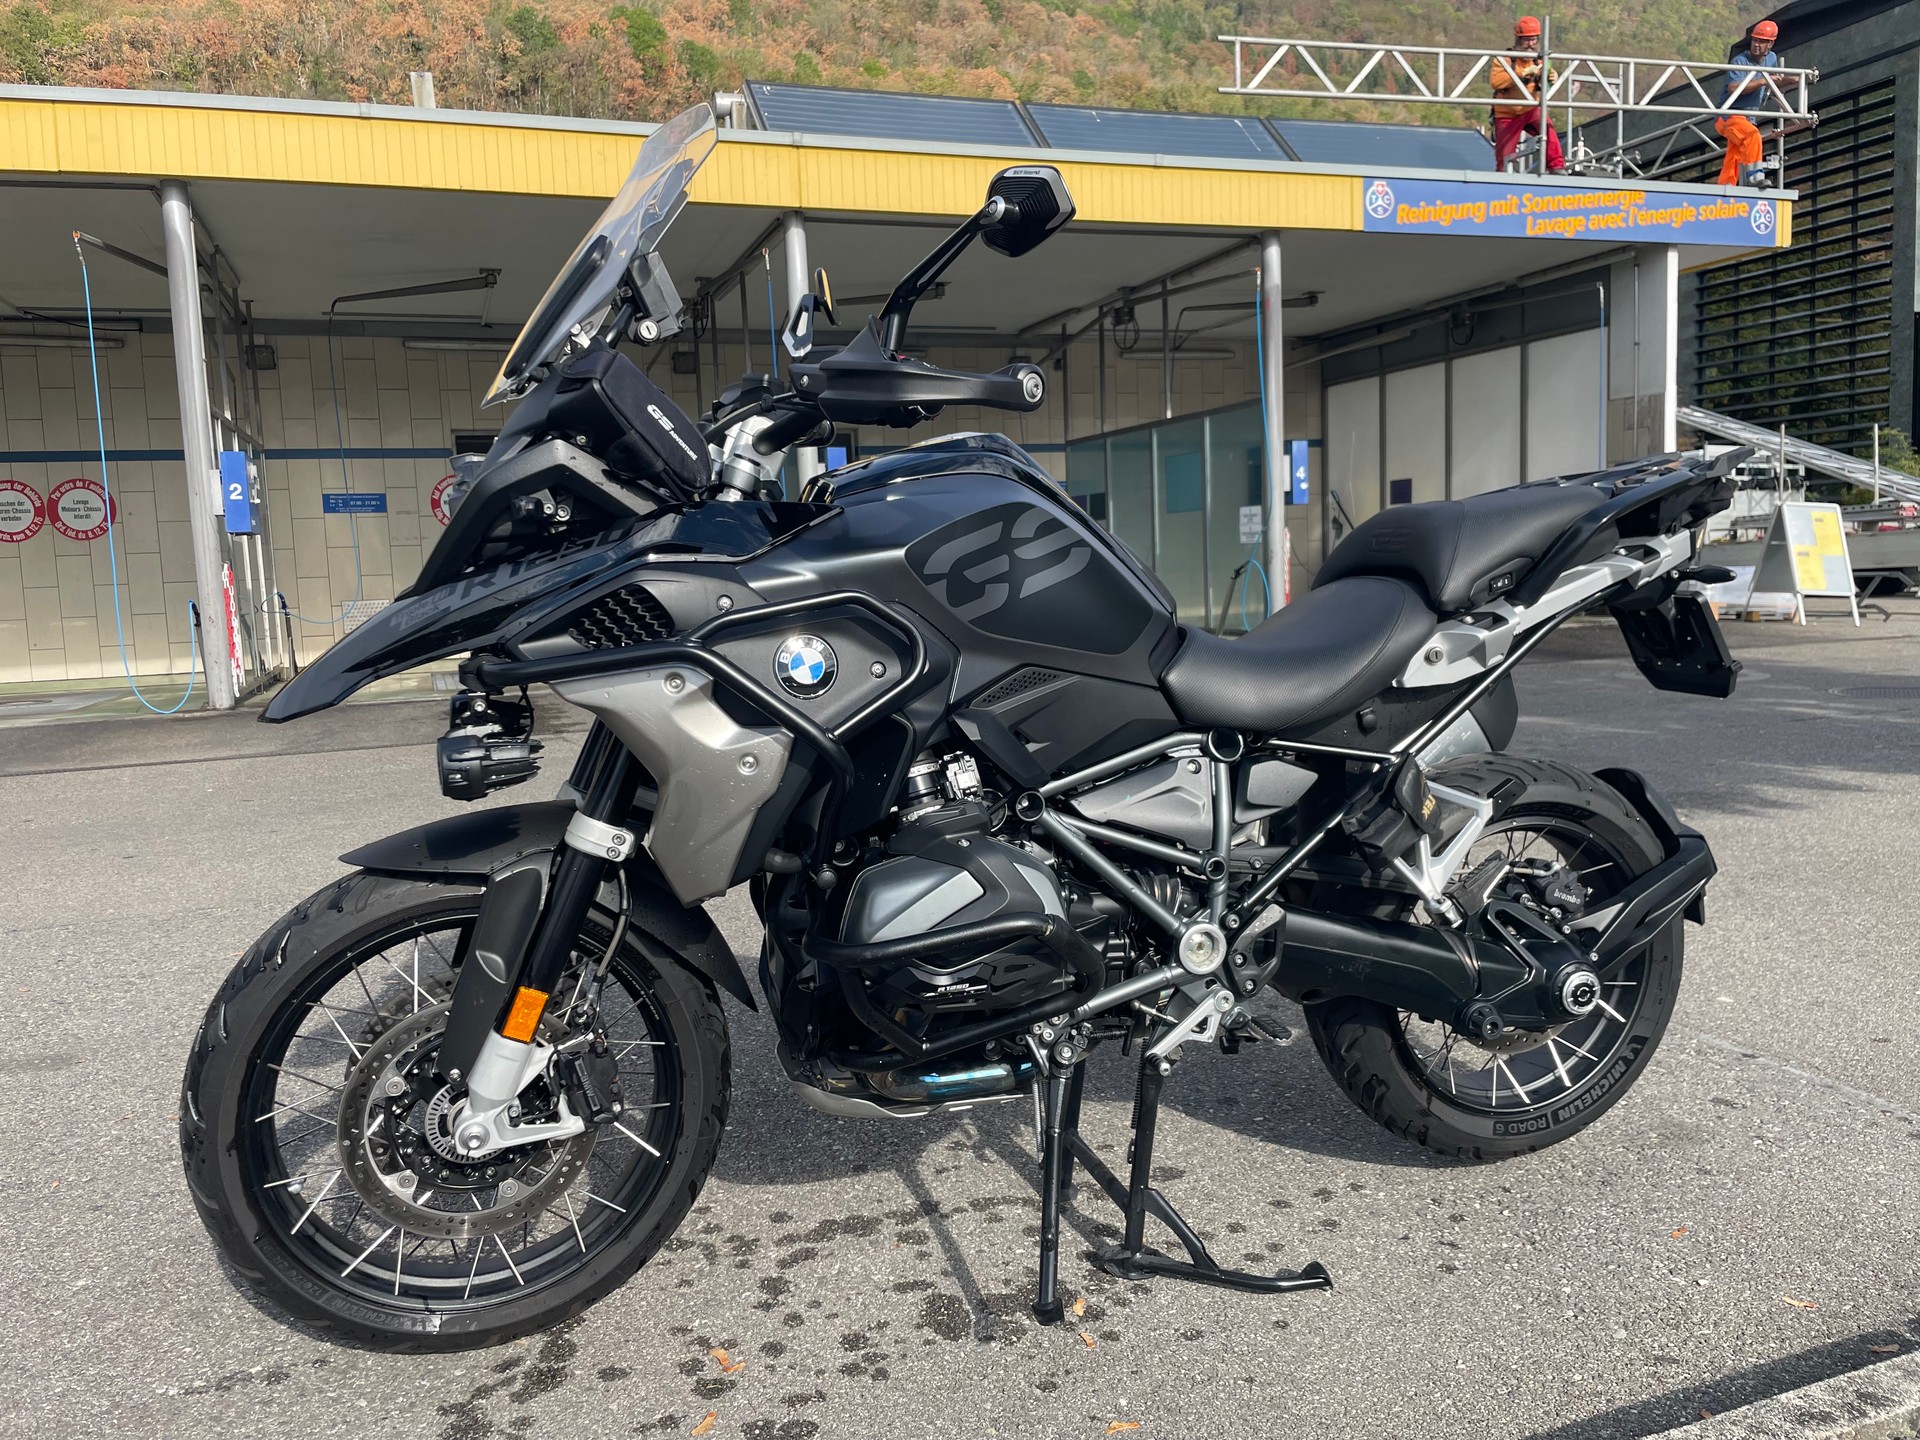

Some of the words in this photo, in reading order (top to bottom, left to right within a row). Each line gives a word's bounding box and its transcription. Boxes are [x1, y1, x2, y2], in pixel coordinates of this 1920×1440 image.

[1397, 199, 1487, 227] Reinigung
[1489, 194, 1520, 217] mit
[1521, 190, 1647, 214] Sonnenenergie
[1526, 215, 1587, 238] Lavage
[1588, 211, 1627, 230] avec
[1628, 202, 1697, 229] l'énergie
[1699, 198, 1750, 221] solaire
[646, 404, 675, 431] GS
[668, 430, 698, 461] ADVENTURE
[1296, 465, 1306, 480] 4
[229, 483, 243, 500] 2
[922, 506, 1092, 622] GS
[1553, 888, 1581, 905] brembo
[580, 1075, 596, 1098] BMW
[1558, 1060, 1627, 1121] MICHELIN
[1508, 1116, 1547, 1134] ROAD
